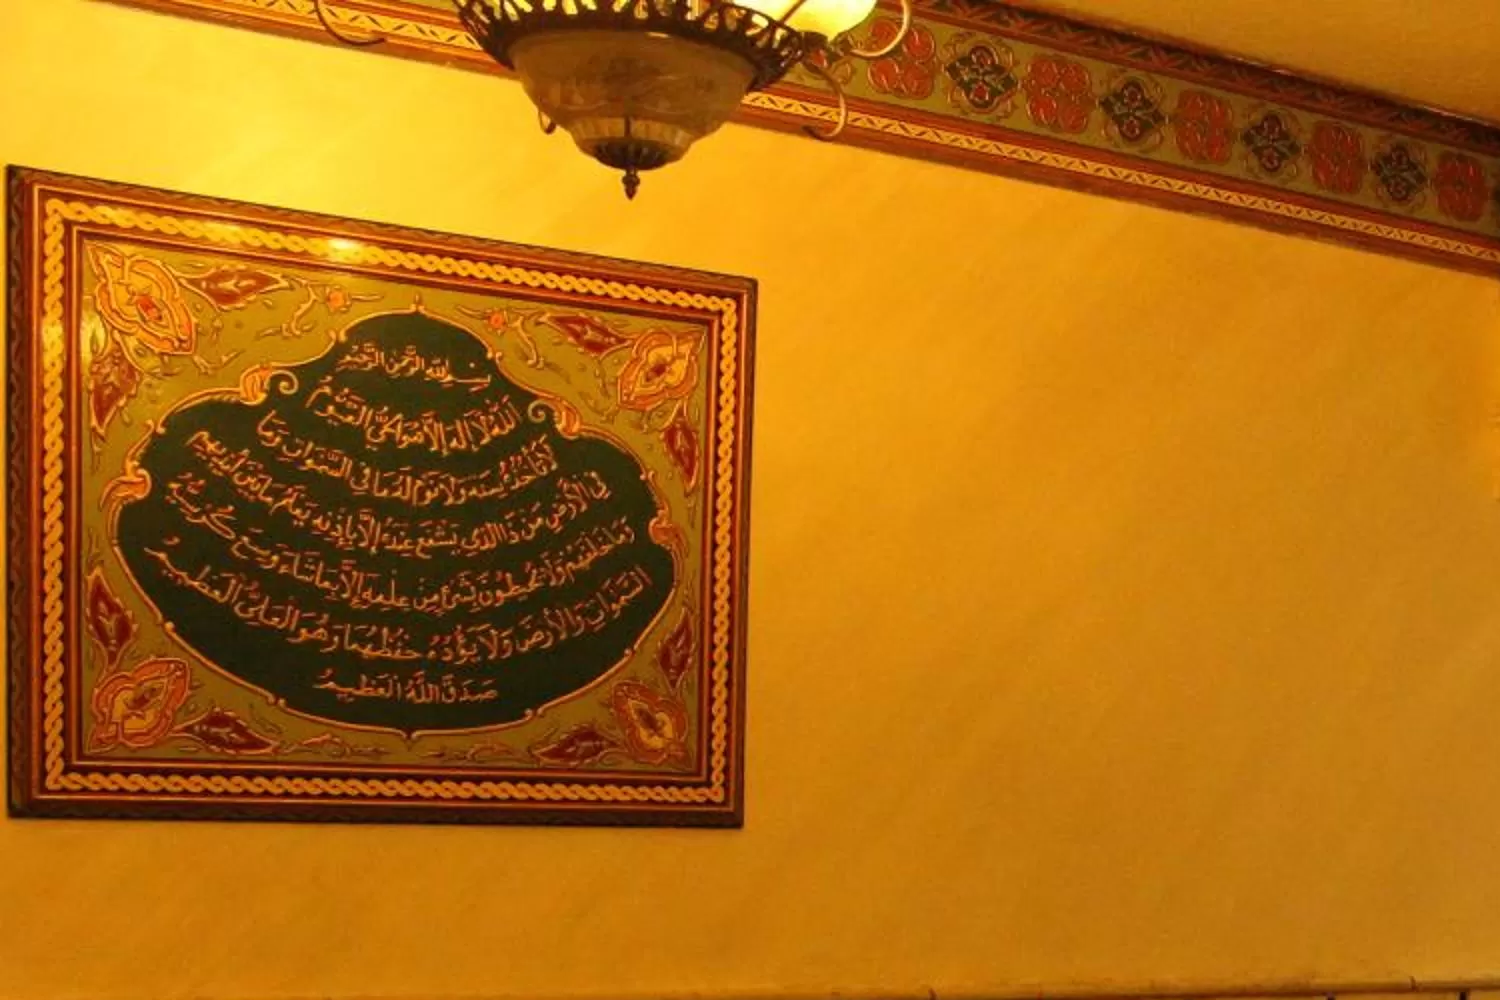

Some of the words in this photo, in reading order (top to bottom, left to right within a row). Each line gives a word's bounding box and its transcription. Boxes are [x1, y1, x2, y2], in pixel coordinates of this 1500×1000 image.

[336, 341, 385, 372] الرحيم
[385, 344, 425, 378] الرحمن
[312, 667, 402, 704] العظيم
[405, 670, 440, 705] الله
